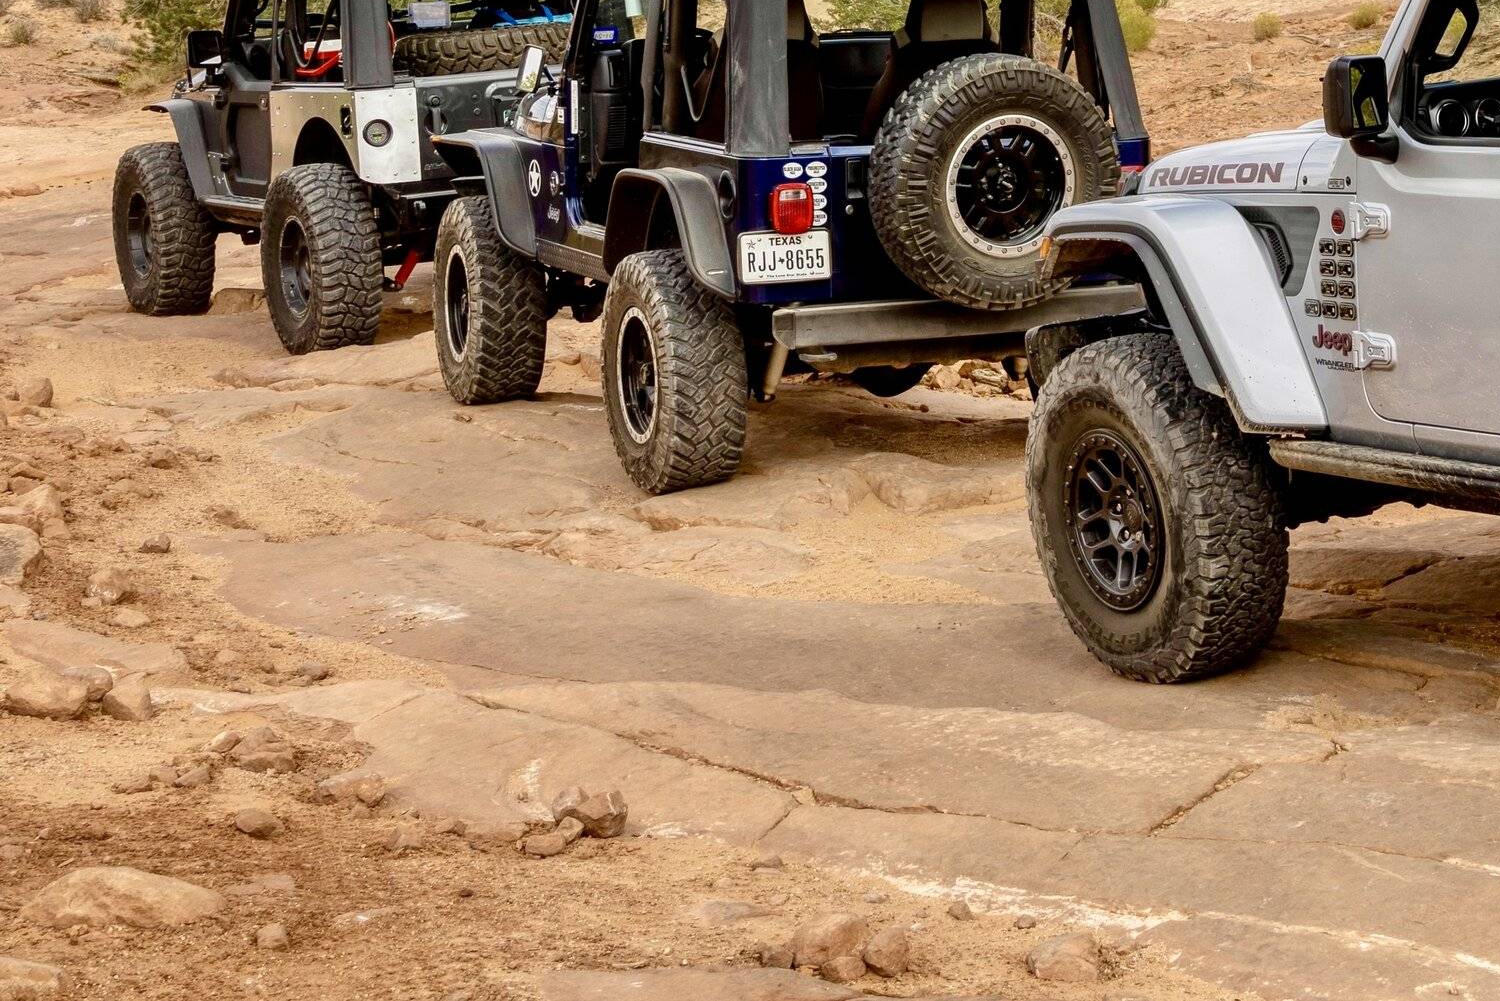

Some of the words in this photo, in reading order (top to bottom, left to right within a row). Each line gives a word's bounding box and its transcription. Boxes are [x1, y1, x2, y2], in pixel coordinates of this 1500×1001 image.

[1149, 162, 1285, 187] RUBICON
[547, 203, 560, 224] Jeep
[768, 235, 802, 246] TEXAS
[1312, 324, 1352, 356] Jeep
